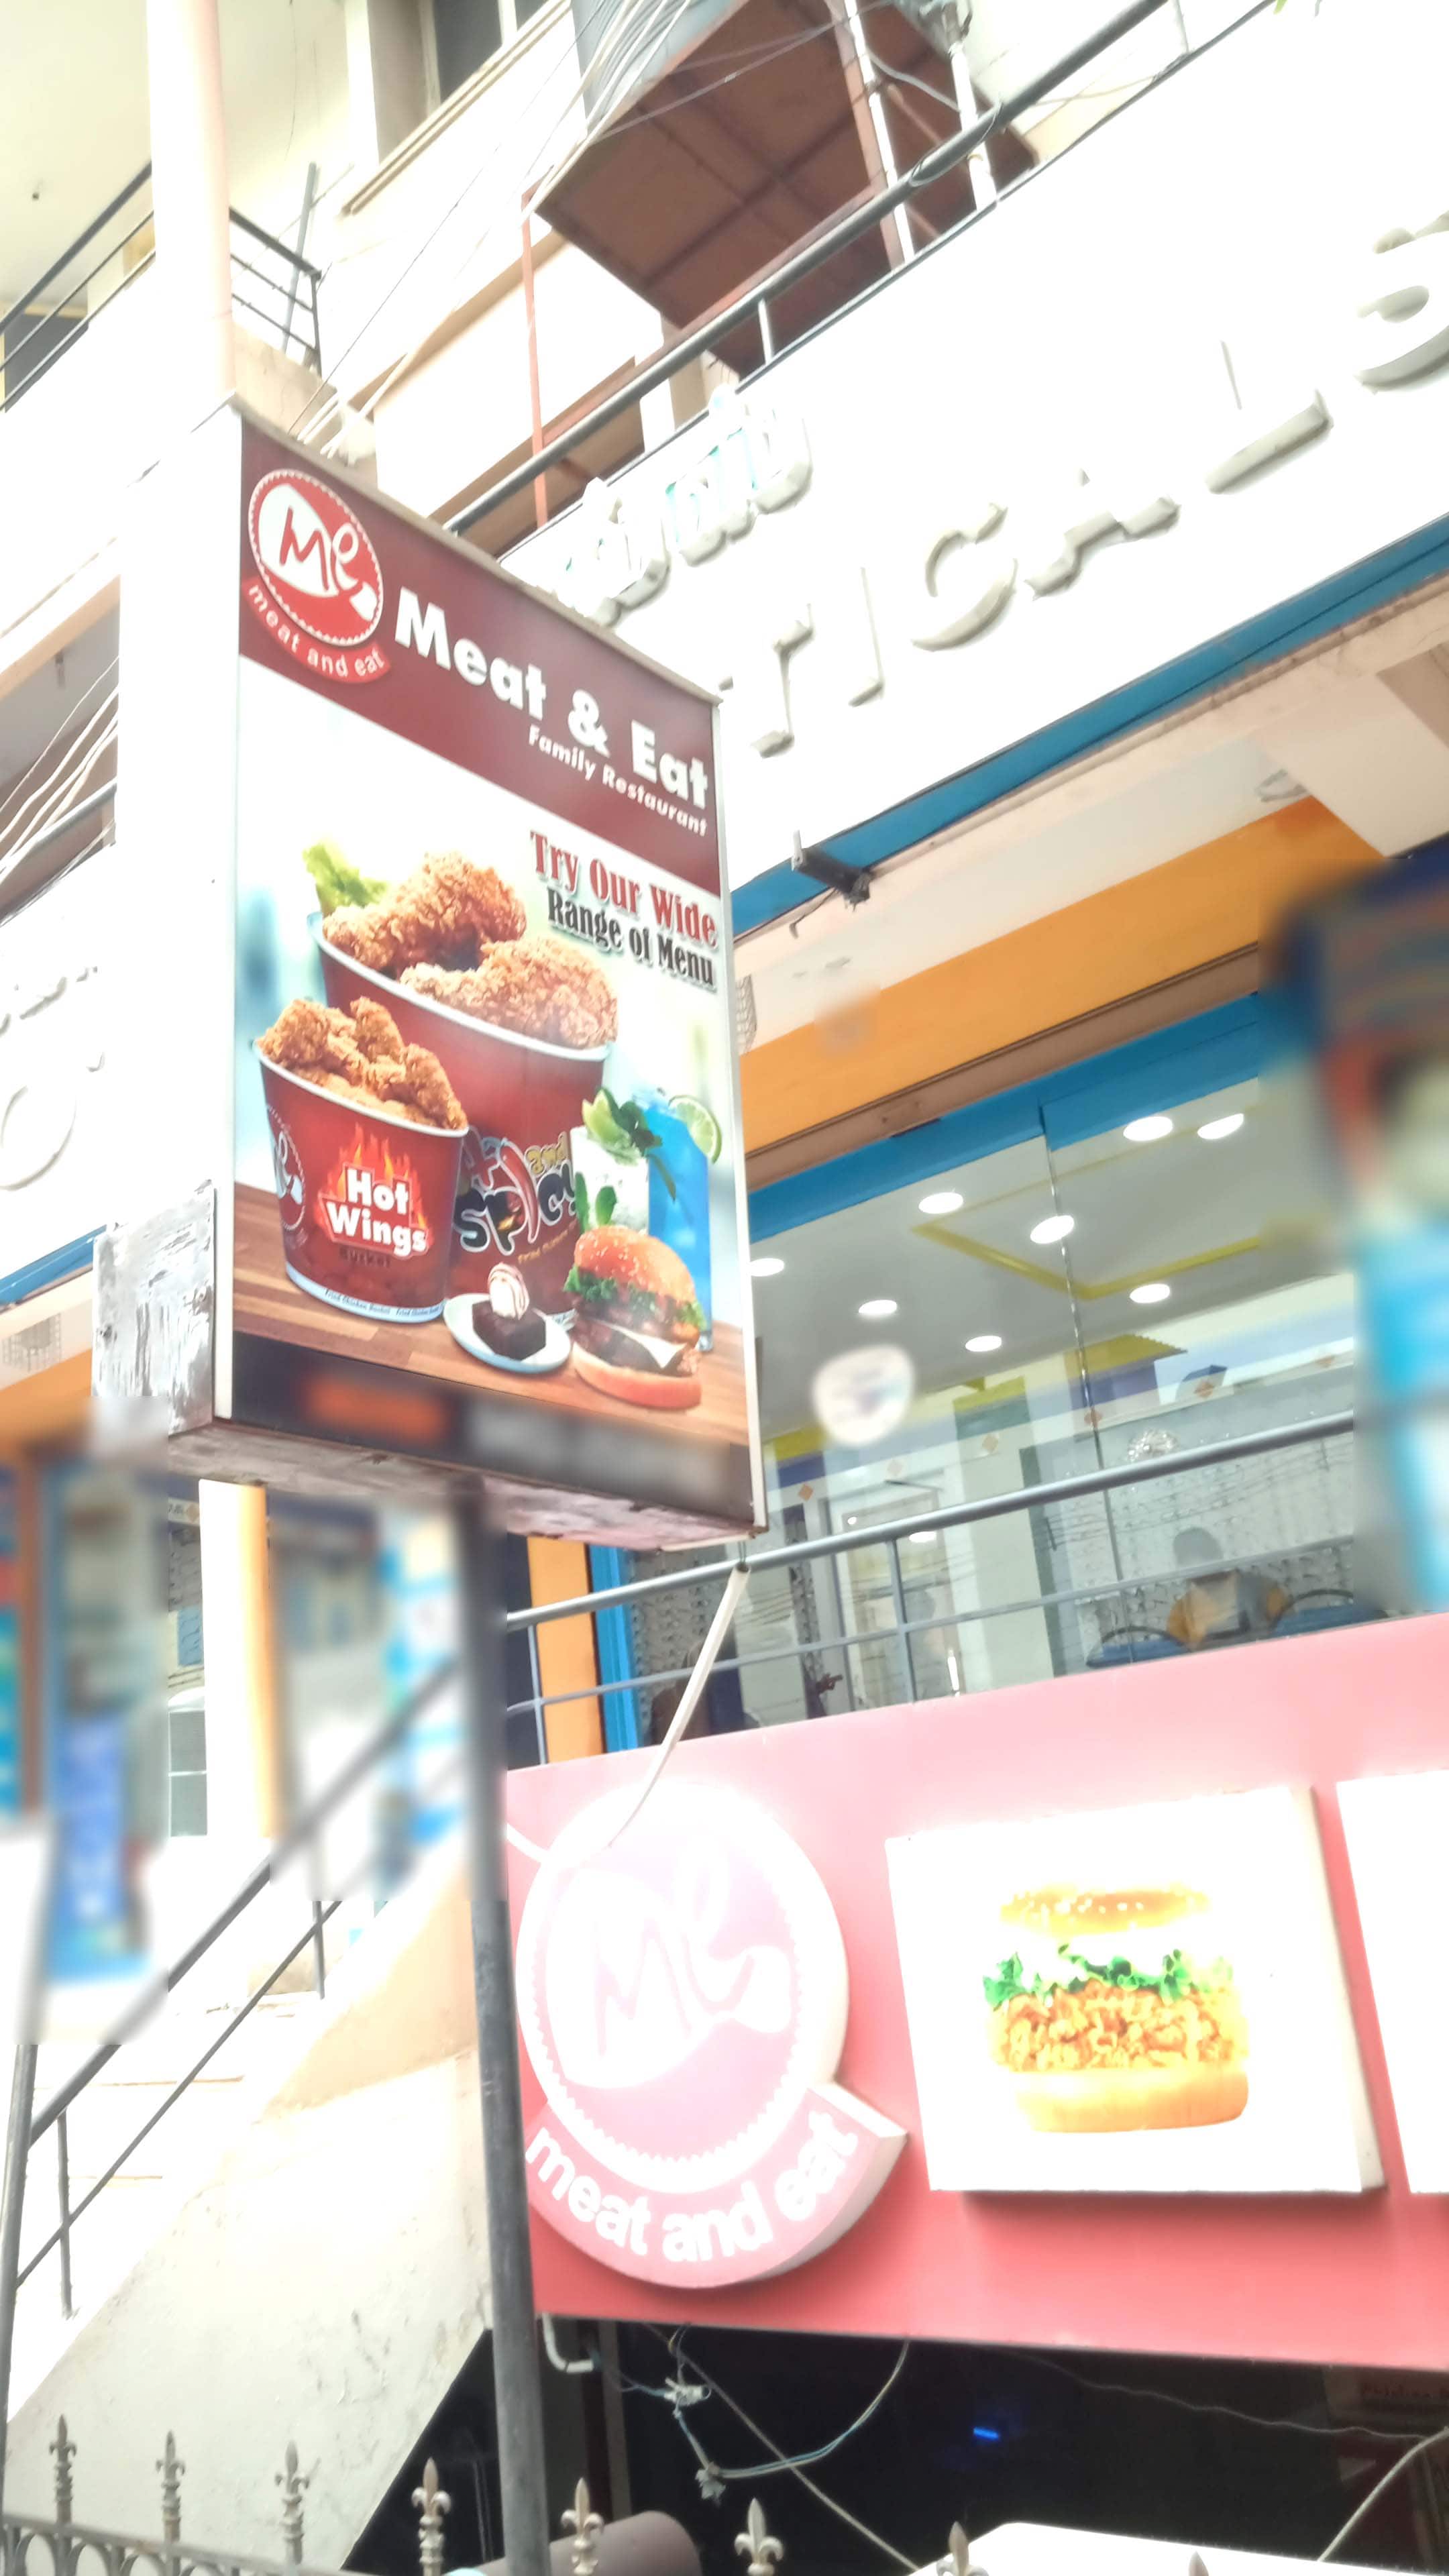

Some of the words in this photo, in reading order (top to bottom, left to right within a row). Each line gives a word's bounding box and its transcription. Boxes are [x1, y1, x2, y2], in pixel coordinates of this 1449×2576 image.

[249, 584, 301, 653] meat
[307, 647, 348, 677] and
[354, 646, 385, 677] eat
[394, 587, 547, 720] Meat
[567, 690, 610, 757] &
[631, 720, 708, 810] Eat
[529, 725, 596, 782] Family
[602, 763, 707, 837] Restaurant
[530, 830, 578, 893] Try
[589, 858, 640, 914] Our
[649, 883, 717, 948] Wide
[547, 885, 622, 949] Range
[629, 926, 650, 961] of
[657, 933, 714, 986] Menu
[326, 1201, 427, 1257] Wings
[347, 1168, 409, 1215] Hot
[525, 2126, 652, 2255] meat
[661, 2181, 774, 2263] and
[774, 2110, 859, 2222] eat
